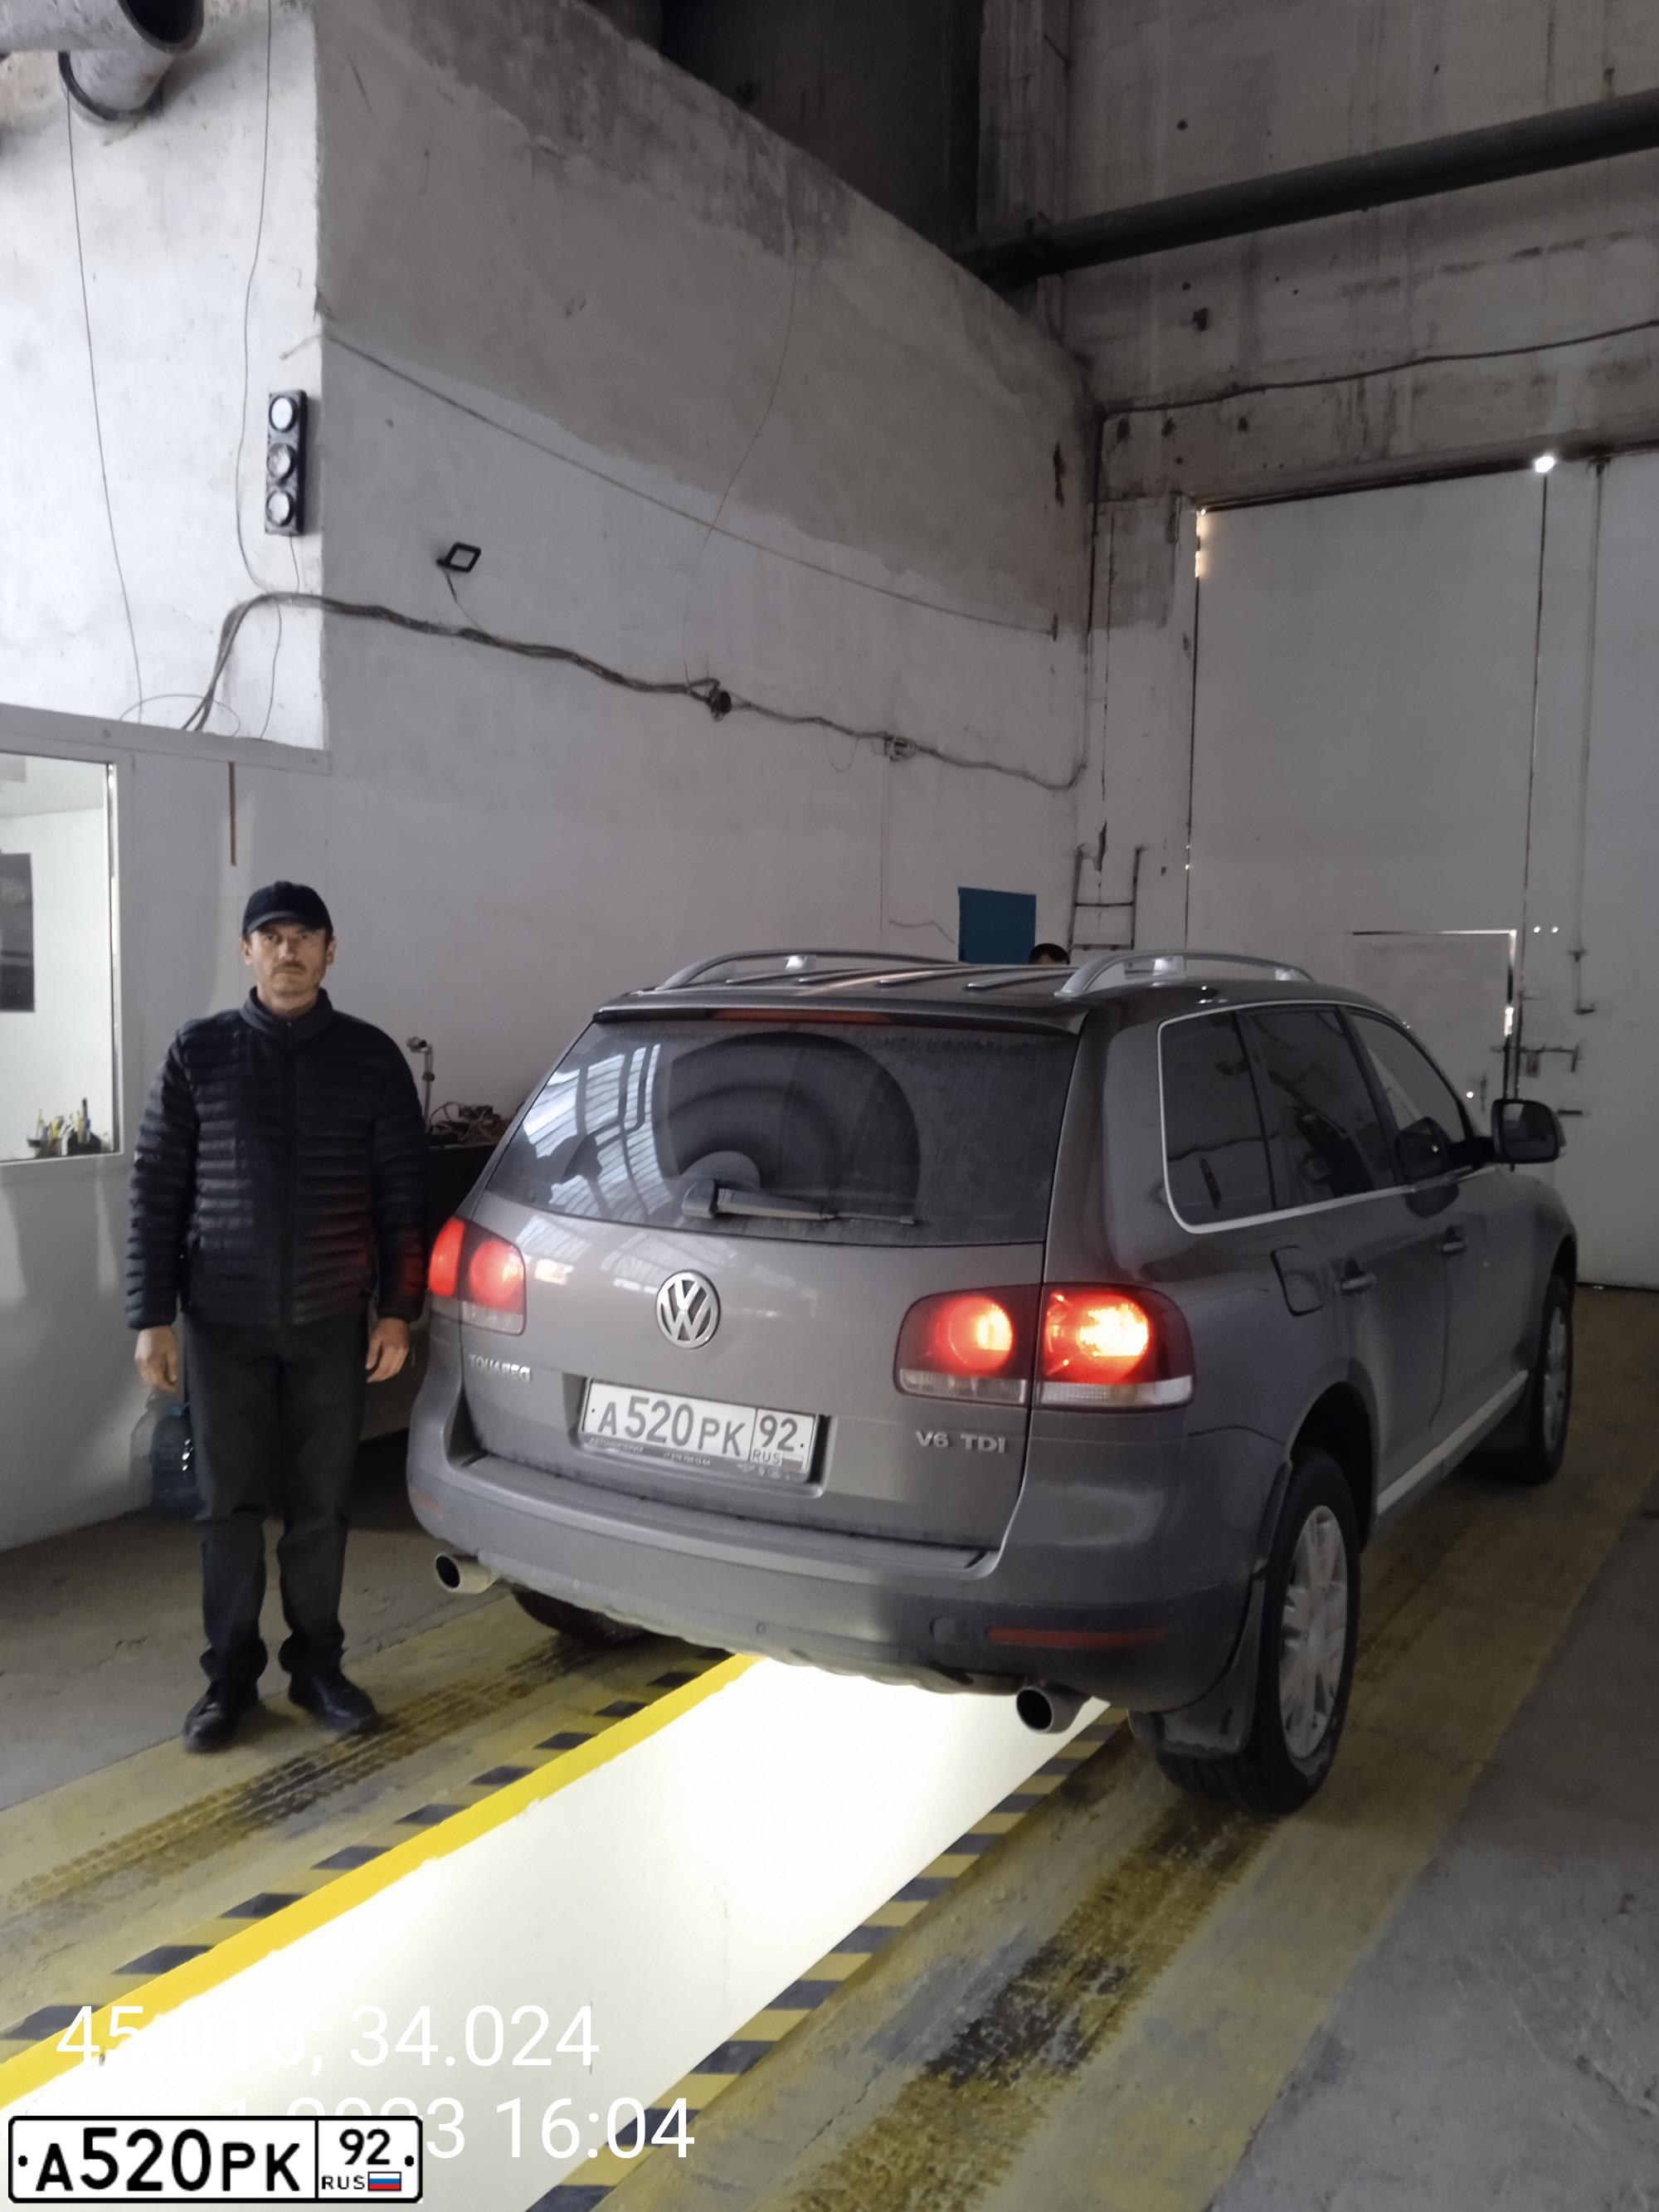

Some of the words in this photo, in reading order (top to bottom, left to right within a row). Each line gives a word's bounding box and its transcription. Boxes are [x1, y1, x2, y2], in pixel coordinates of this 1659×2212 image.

[759, 1415, 798, 1452] 92
[915, 1429, 949, 1448] V6
[961, 1434, 1006, 1454] TDI
[752, 1449, 781, 1465] RUS
